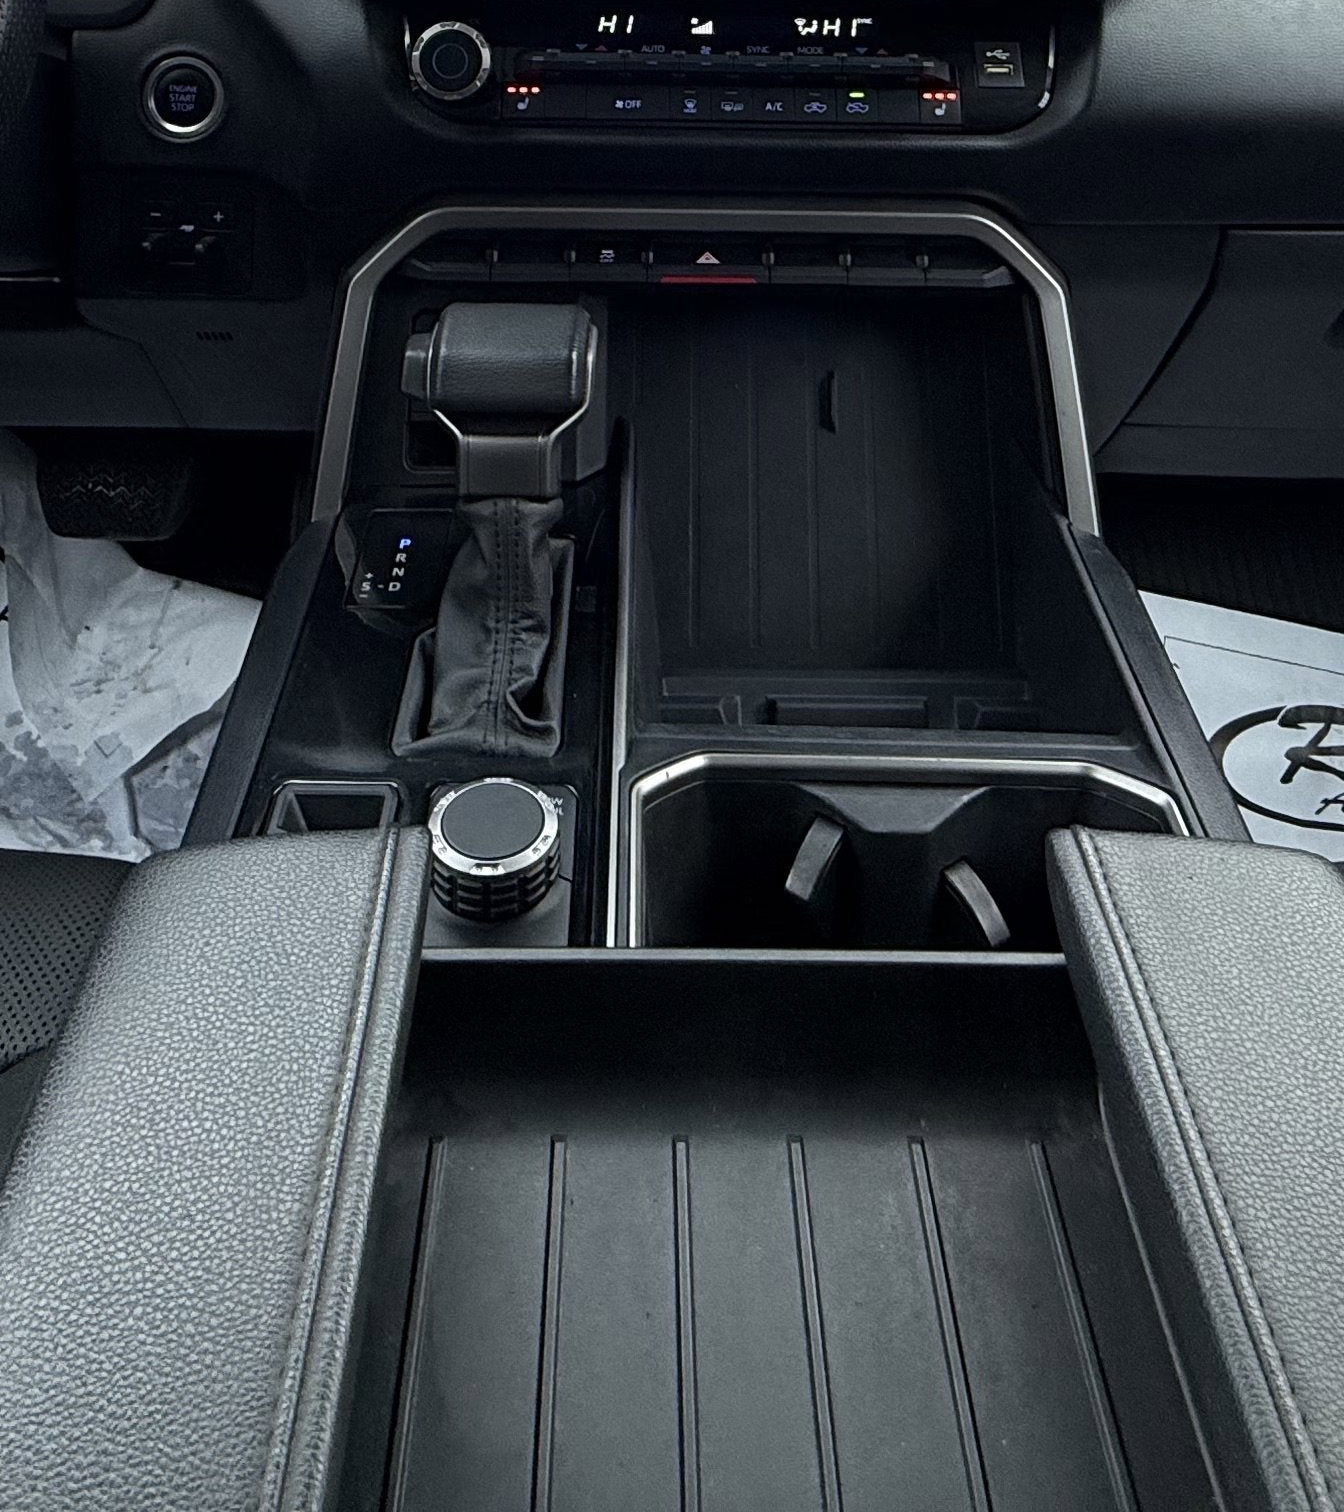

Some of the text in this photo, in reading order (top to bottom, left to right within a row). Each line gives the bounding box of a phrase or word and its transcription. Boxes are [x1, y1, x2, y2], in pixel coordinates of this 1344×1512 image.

[641, 44, 665, 53] AUTO
[746, 45, 769, 54] SYNC
[797, 46, 824, 55] MODE
[171, 103, 194, 111] STOP
[624, 100, 642, 110] OFF
[765, 101, 784, 112] A/C
[399, 539, 411, 549] P
[396, 553, 406, 563] R
[392, 568, 404, 576] N
[360, 582, 401, 591] S D
